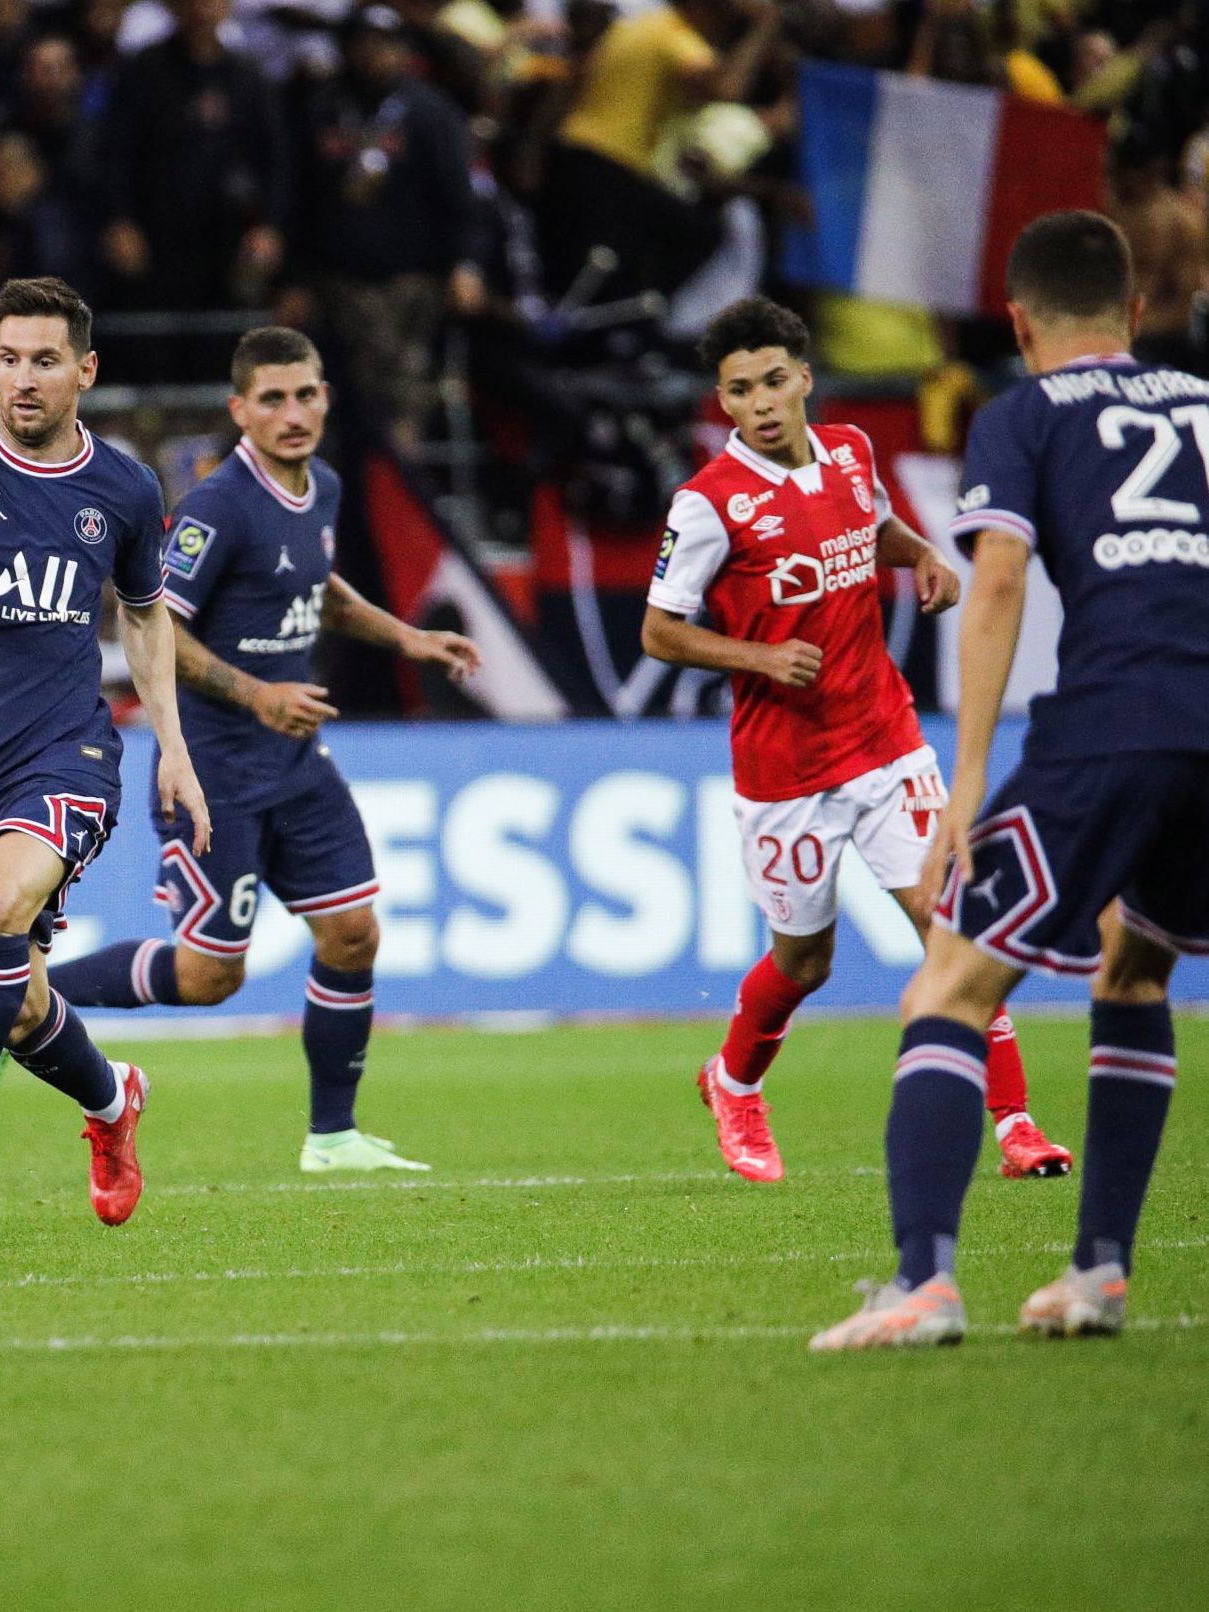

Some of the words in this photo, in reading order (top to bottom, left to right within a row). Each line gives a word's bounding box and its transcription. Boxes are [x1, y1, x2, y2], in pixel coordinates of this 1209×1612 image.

[1, 605, 36, 622] LIVE
[758, 833, 824, 886] 20
[229, 873, 258, 928] 6
